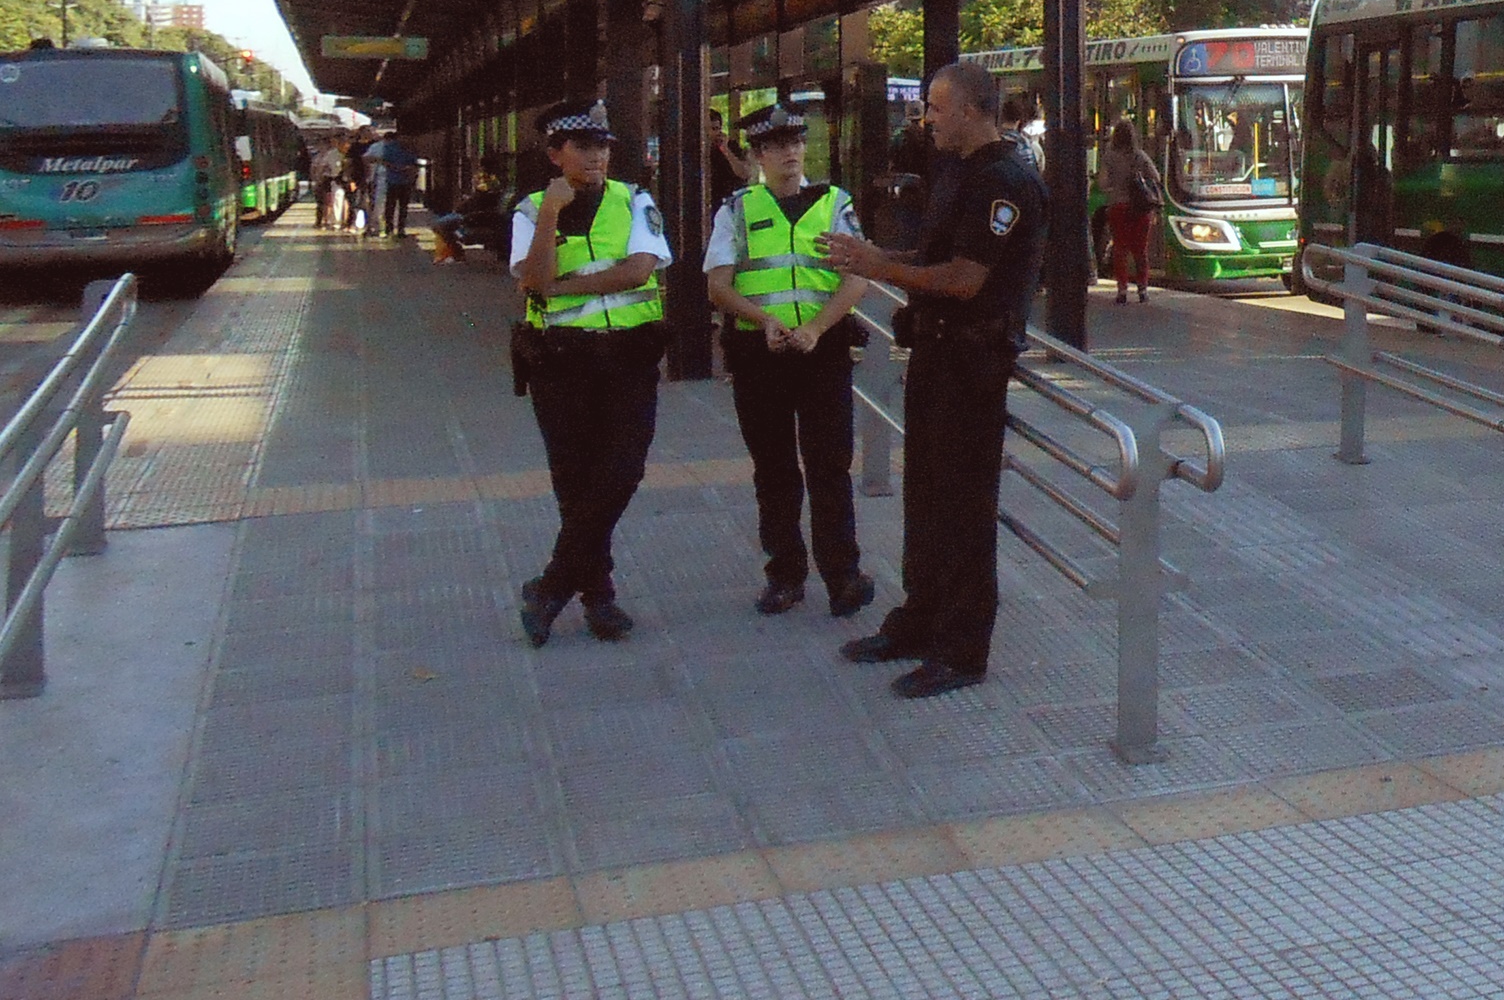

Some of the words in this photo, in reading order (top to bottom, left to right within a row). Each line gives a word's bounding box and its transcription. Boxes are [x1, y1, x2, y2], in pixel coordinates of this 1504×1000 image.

[1206, 42, 1255, 68] 70
[39, 156, 139, 173] Metalpar
[59, 179, 101, 203] 10
